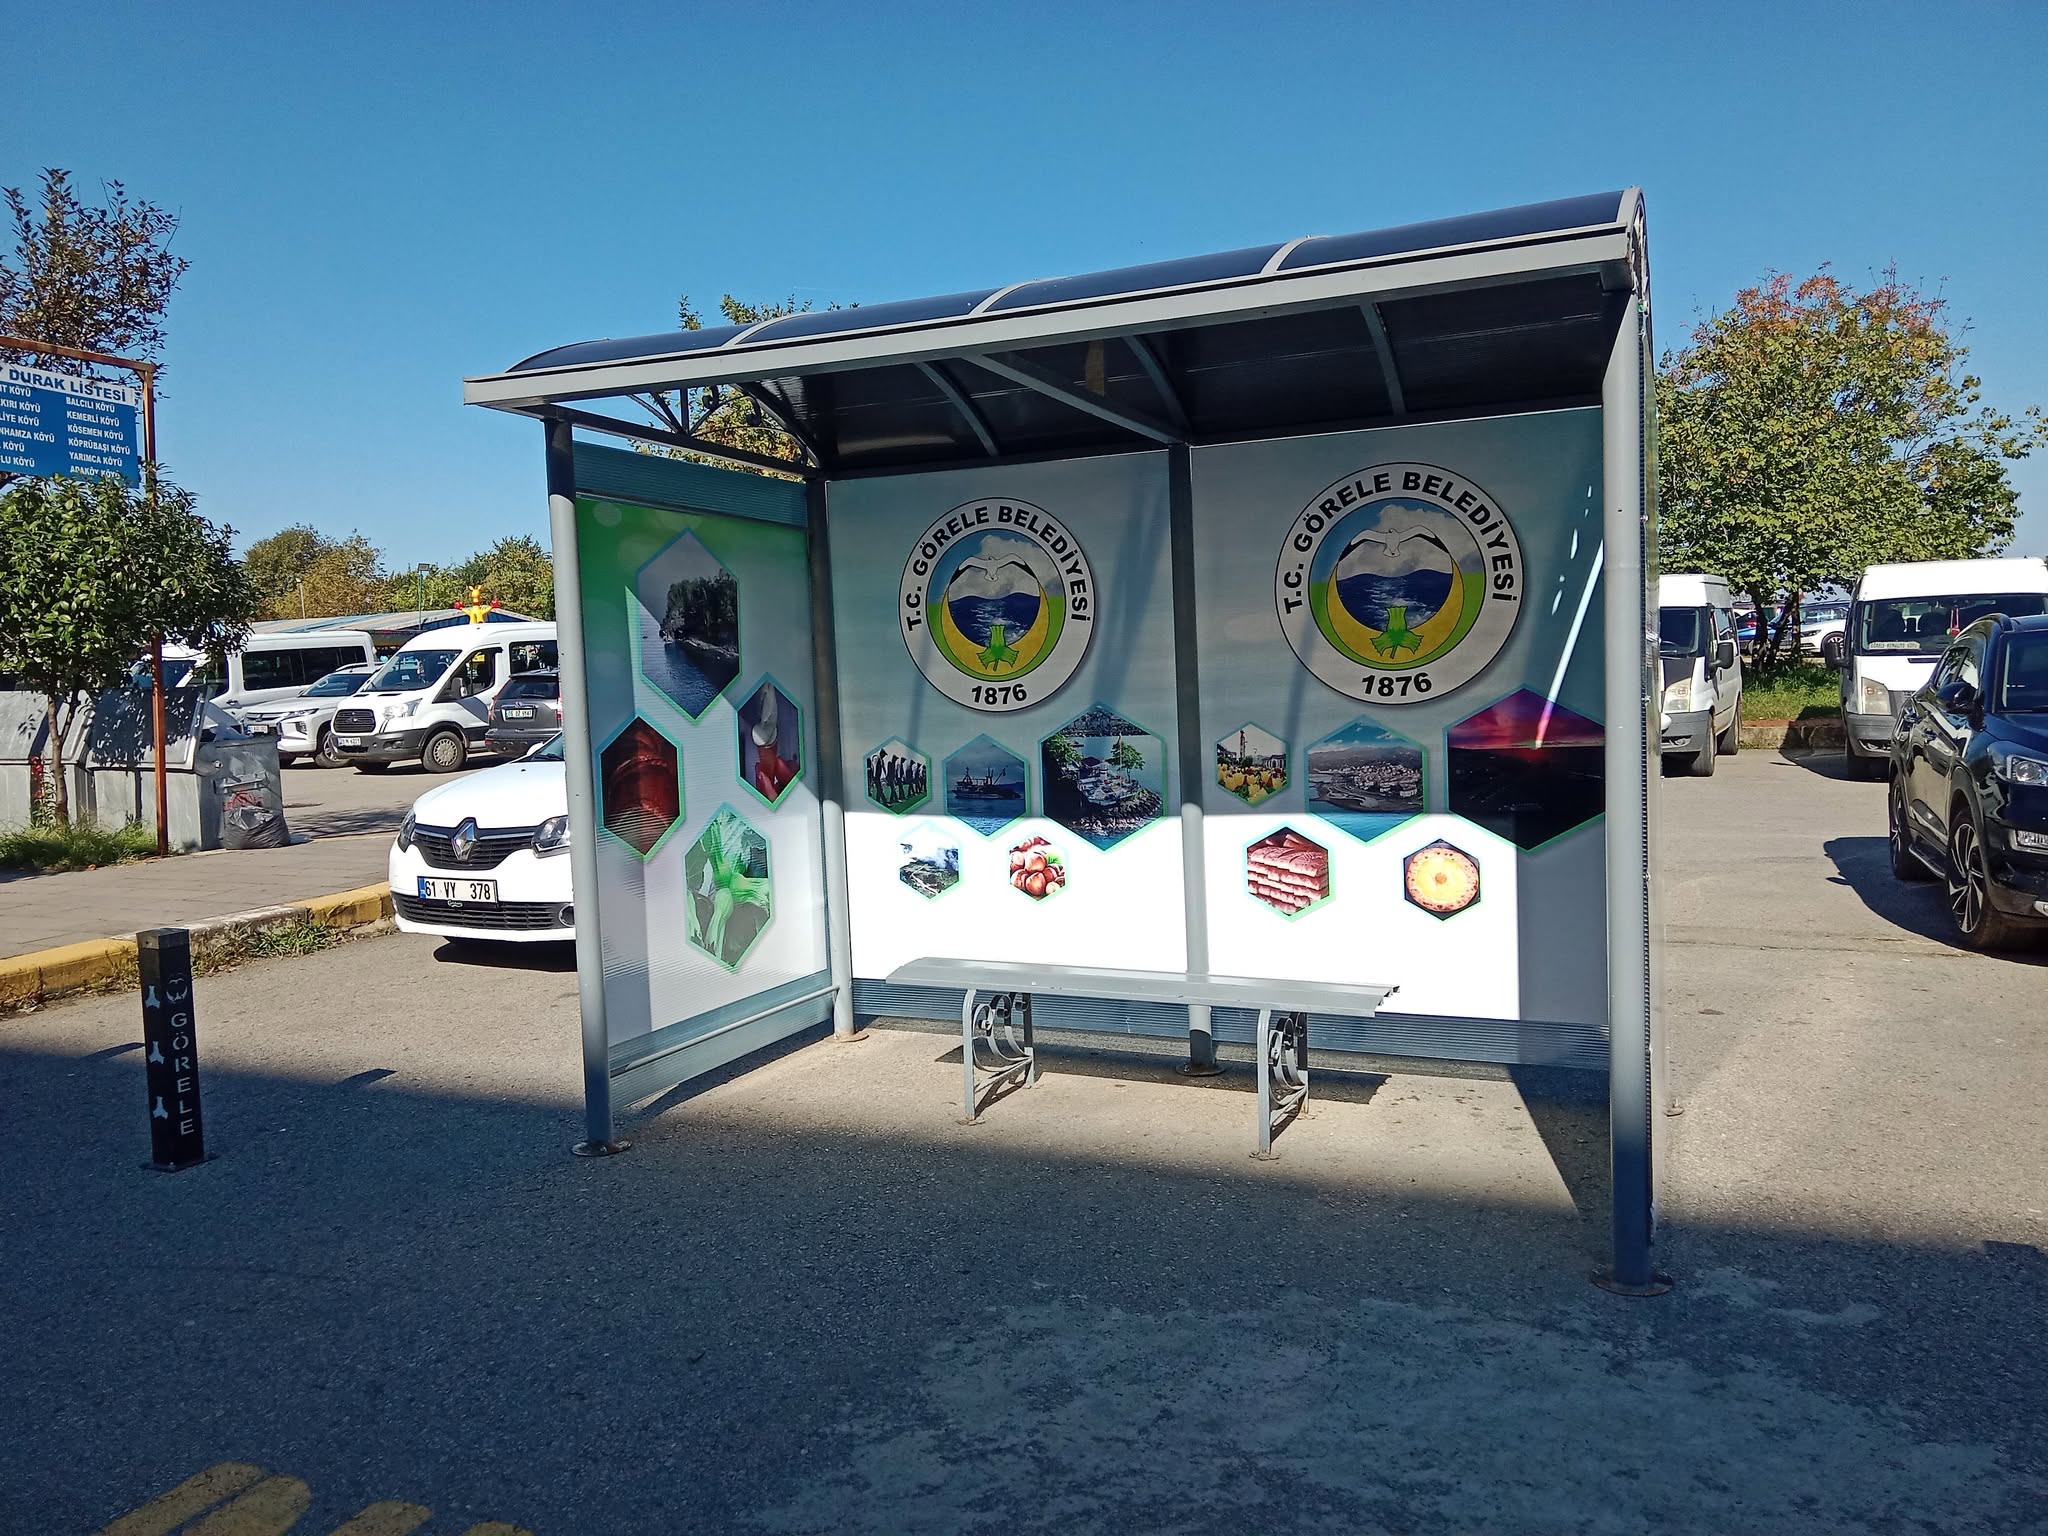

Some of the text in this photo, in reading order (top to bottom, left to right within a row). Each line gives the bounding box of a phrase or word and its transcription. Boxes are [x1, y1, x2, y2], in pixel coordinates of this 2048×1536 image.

[9, 369, 126, 401] DURAK LİSTESİ
[9, 386, 31, 397] KÖYÜ
[19, 402, 41, 413] KÖYÜ
[95, 402, 115, 413] KÖYÜ
[18, 415, 40, 428] KÖYÜ
[66, 411, 120, 427] KEMERLİ KÖYÜ
[33, 432, 55, 443] KÖYÜ
[103, 430, 124, 441] KÖYÜ
[2, 441, 25, 452] KÖYÜ
[68, 438, 131, 455] KÖPRÜBAŞI KÖYÜ
[13, 456, 35, 468] KÖYÜ
[102, 456, 123, 467] KÖYÜ
[1281, 471, 1518, 615] T.C. GÖRELE BELEDİYESİ
[905, 505, 1091, 632] T.C. GÖRELE BELEDİYESİ
[1361, 672, 1432, 697] 1876
[971, 684, 1027, 705] 1876
[425, 880, 491, 900] 61 VY 378
[171, 1011, 195, 1136] GÖRELE
